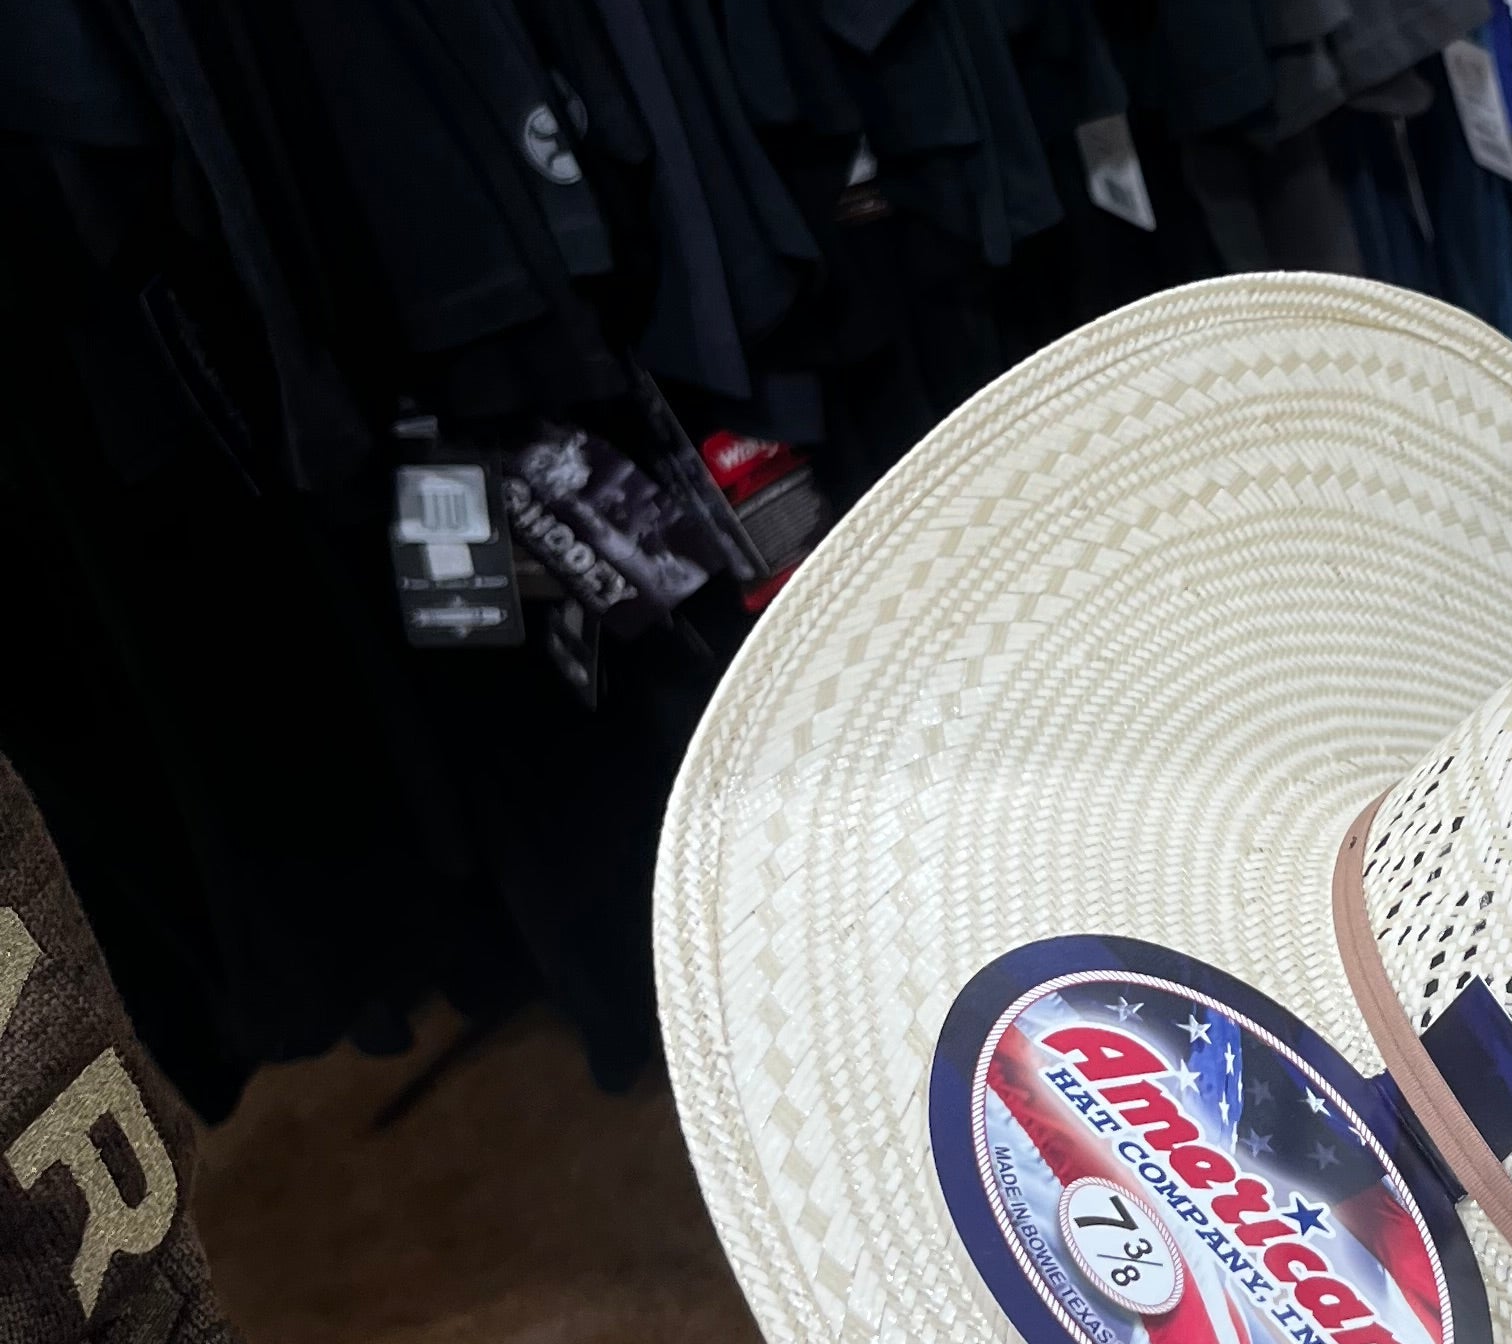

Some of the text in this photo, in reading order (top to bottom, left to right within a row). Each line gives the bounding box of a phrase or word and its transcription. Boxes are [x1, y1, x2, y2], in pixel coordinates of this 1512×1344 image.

[994, 1145, 1022, 1199] MADE
[1011, 1201, 1029, 1221] IN
[1020, 1221, 1067, 1288] BOWIE
[1060, 1284, 1113, 1344] TEXAS
[1045, 1067, 1122, 1134] HAT
[1117, 1140, 1274, 1303] COMPANY,
[1073, 1195, 1139, 1231] 7
